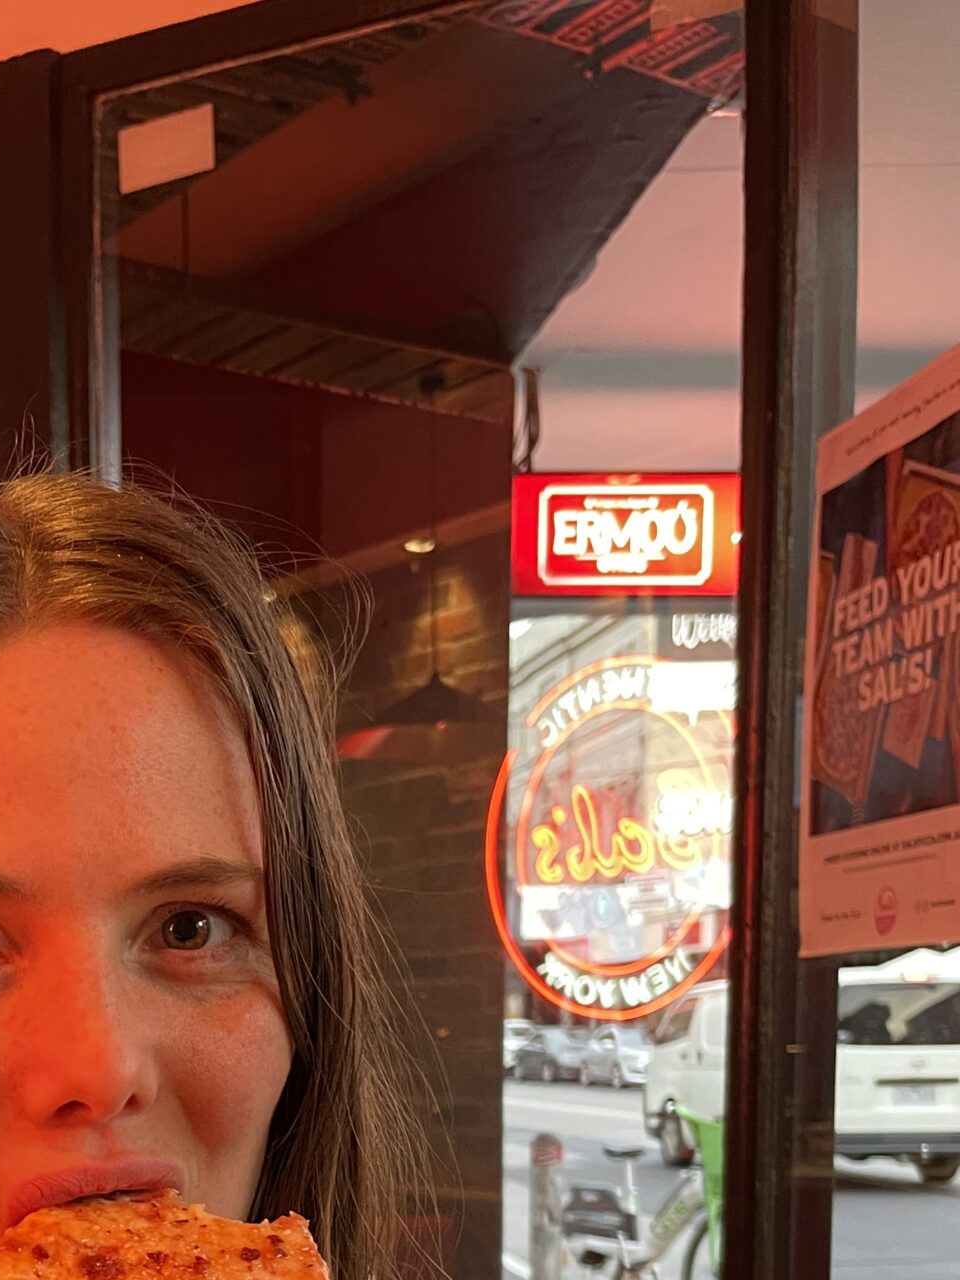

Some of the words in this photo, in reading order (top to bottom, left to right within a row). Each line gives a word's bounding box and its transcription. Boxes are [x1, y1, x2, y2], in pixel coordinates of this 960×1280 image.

[834, 576, 888, 637] FEED
[831, 619, 892, 678] TEAM
[858, 648, 933, 713] SAL'S!
